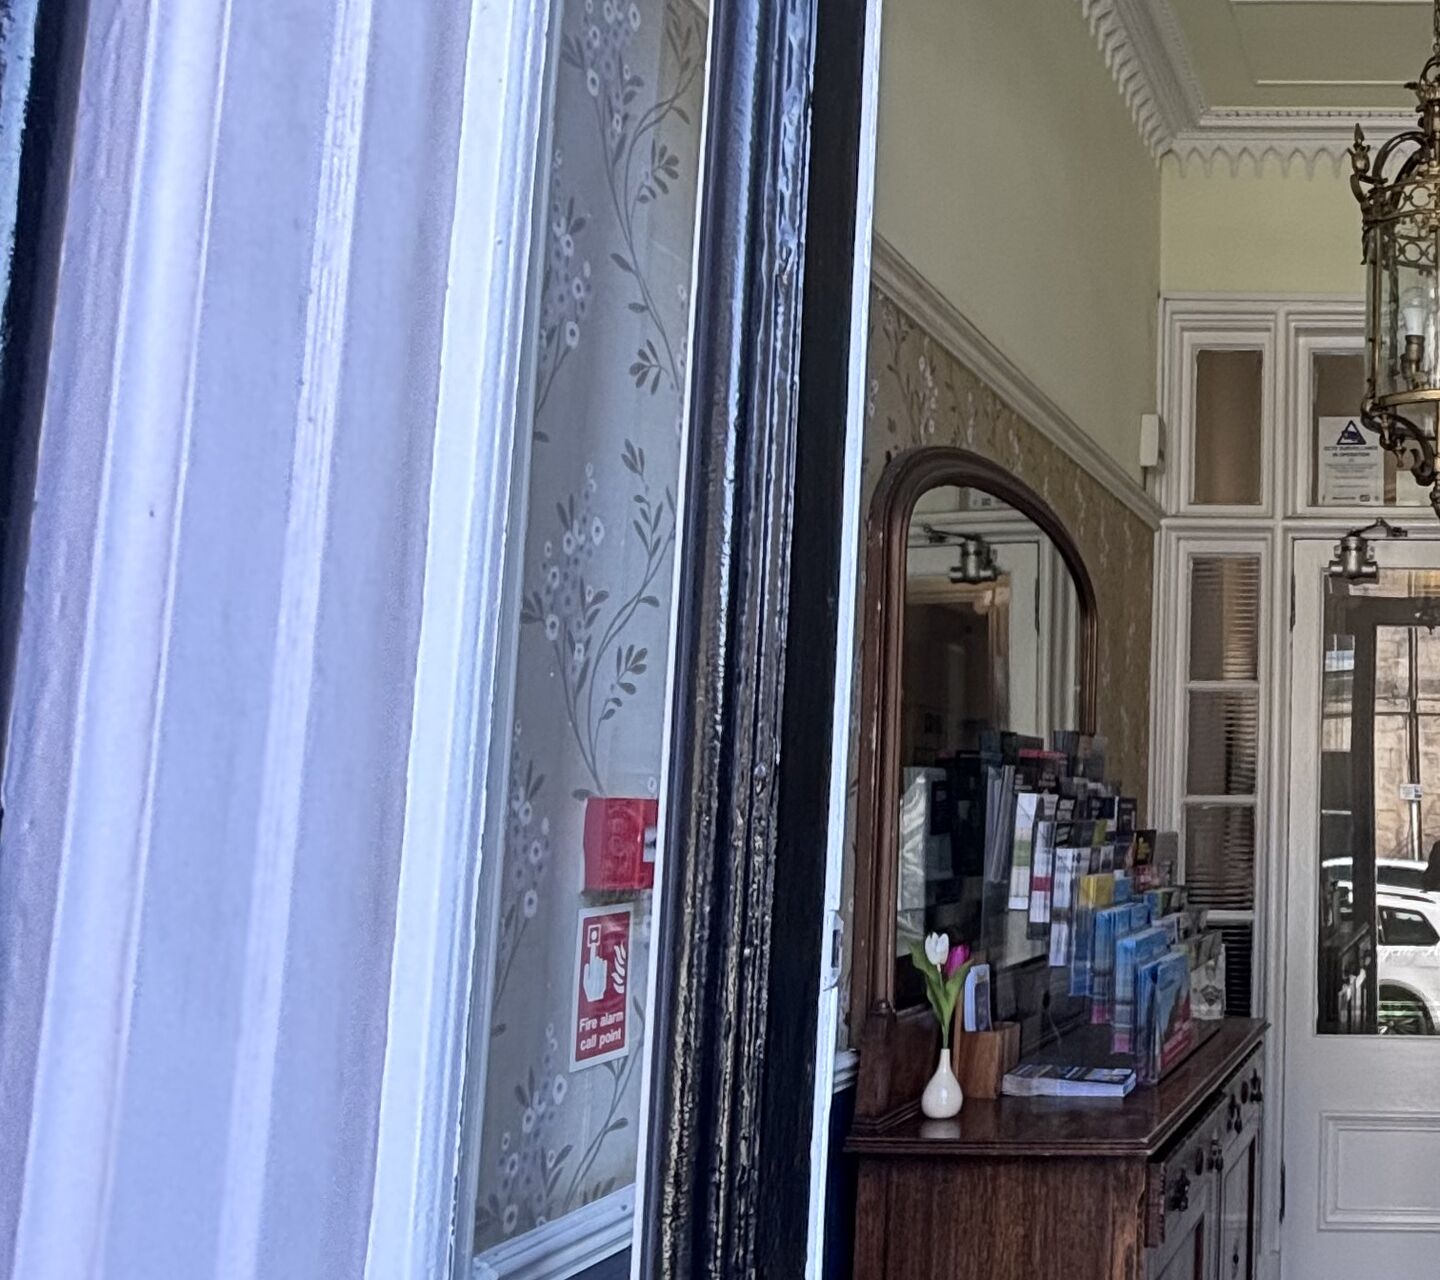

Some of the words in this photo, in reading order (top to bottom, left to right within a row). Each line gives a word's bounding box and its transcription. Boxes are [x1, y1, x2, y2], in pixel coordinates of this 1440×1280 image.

[579, 1017, 598, 1032] Fire
[600, 1011, 624, 1027] alarm
[580, 1033, 597, 1051] call
[599, 1027, 622, 1049] point
